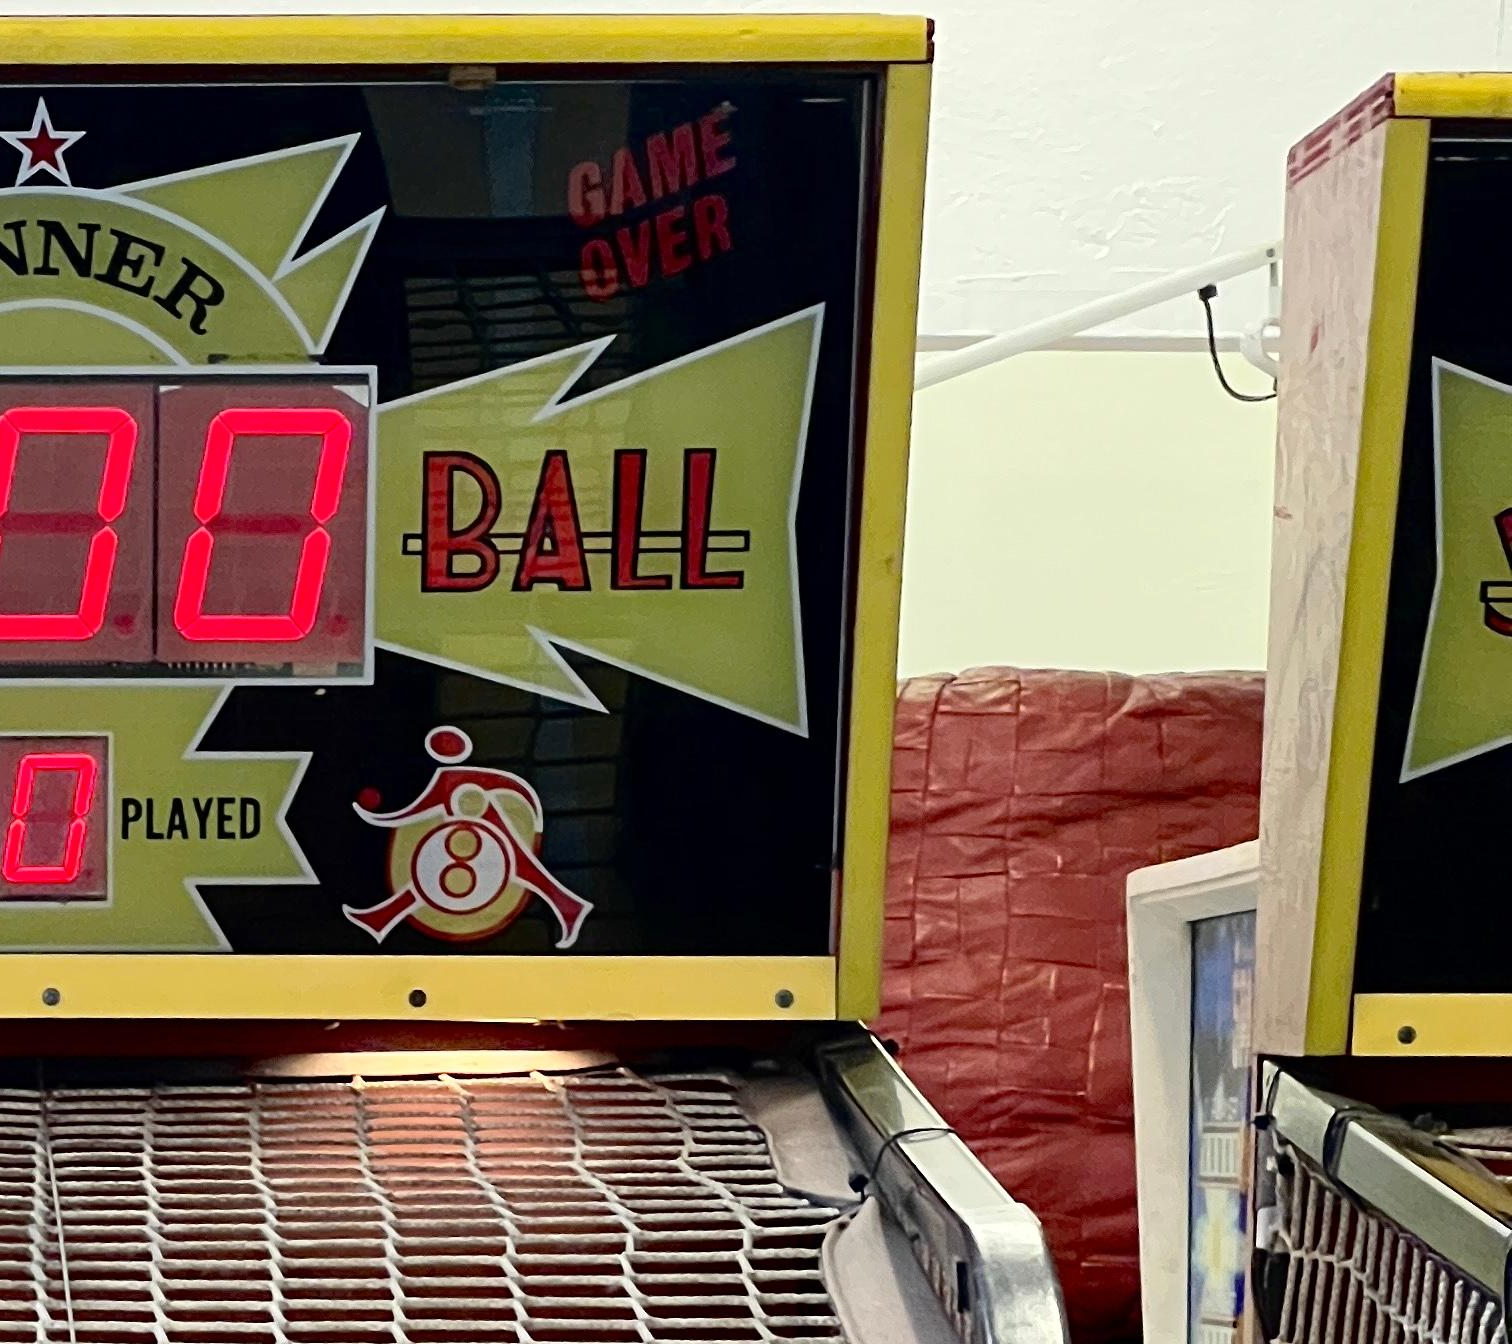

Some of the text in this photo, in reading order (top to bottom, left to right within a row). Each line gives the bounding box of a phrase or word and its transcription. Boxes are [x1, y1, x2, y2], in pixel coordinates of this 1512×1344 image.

[567, 104, 739, 229] GAME
[578, 195, 732, 302] OVER
[420, 448, 746, 591] BALL
[1, 752, 96, 884] 0
[120, 796, 262, 840] PLAYED
[439, 823, 485, 897] 8
